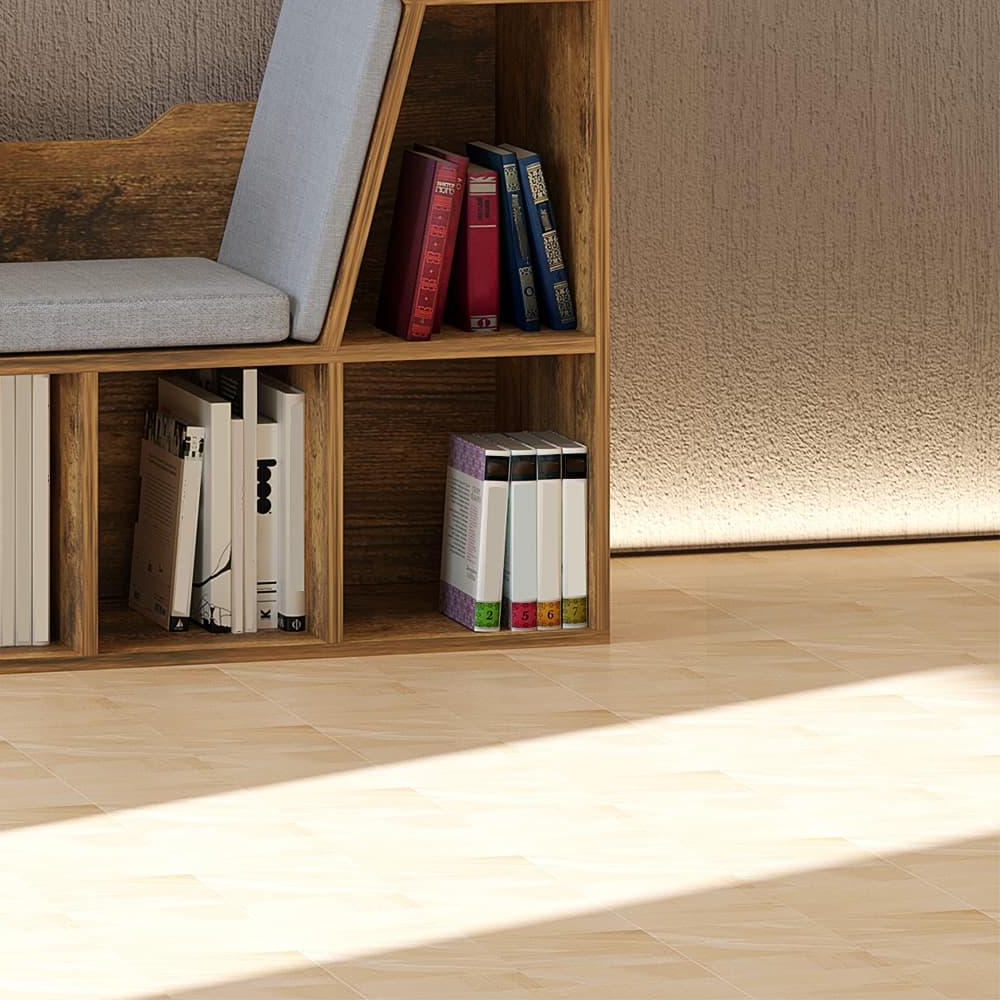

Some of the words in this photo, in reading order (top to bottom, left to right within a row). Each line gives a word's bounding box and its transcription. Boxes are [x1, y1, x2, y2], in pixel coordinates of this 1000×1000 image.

[260, 609, 271, 619] K
[486, 610, 493, 621] 2
[522, 610, 530, 621] 5
[547, 609, 554, 620] 6
[572, 606, 579, 616] 7
